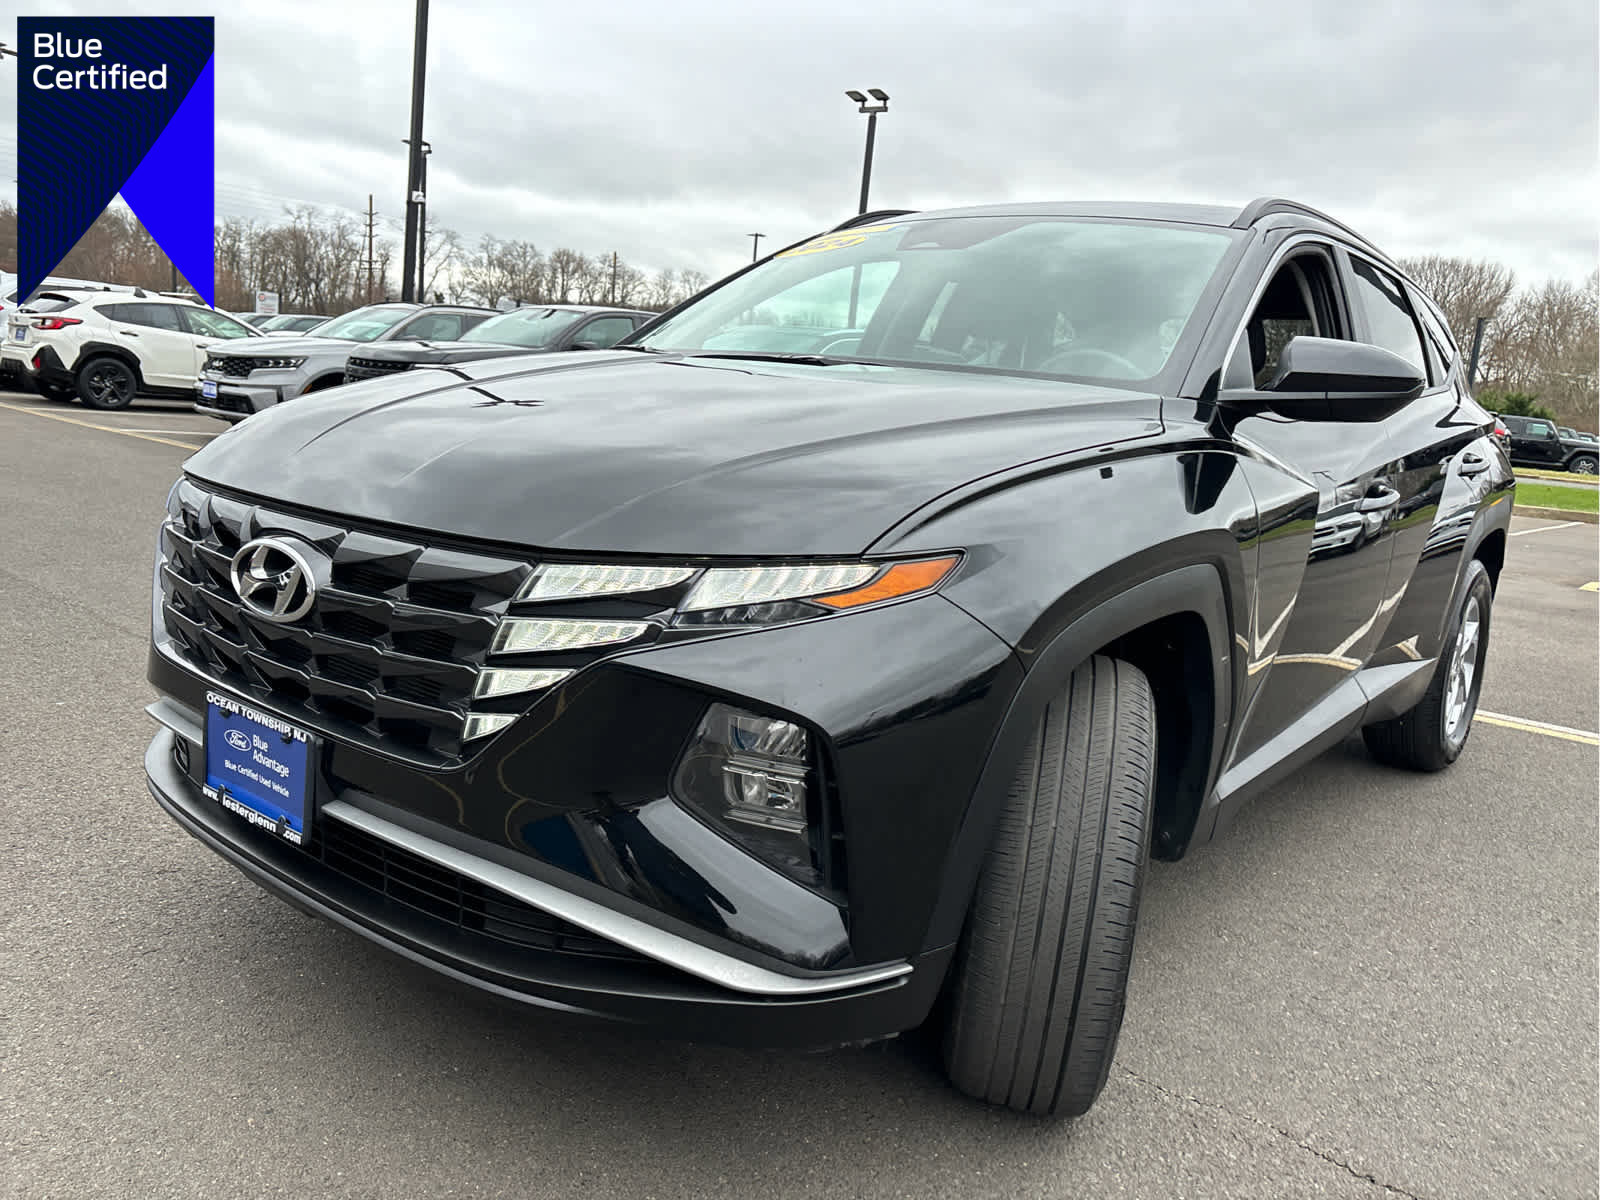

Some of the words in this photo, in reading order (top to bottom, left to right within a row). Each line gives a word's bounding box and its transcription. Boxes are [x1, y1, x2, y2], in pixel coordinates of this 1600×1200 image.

[206, 693, 240, 714] OCEAN
[293, 729, 307, 743] NJ
[229, 732, 247, 748] Ford
[252, 734, 269, 752] Blue
[224, 759, 237, 771] Blue
[237, 764, 259, 781] Certified
[258, 774, 272, 788] Used
[271, 780, 290, 798] Vehicle
[252, 749, 290, 777] Advantage
[222, 795, 277, 833] lesterglenn
[283, 830, 302, 845] .com
